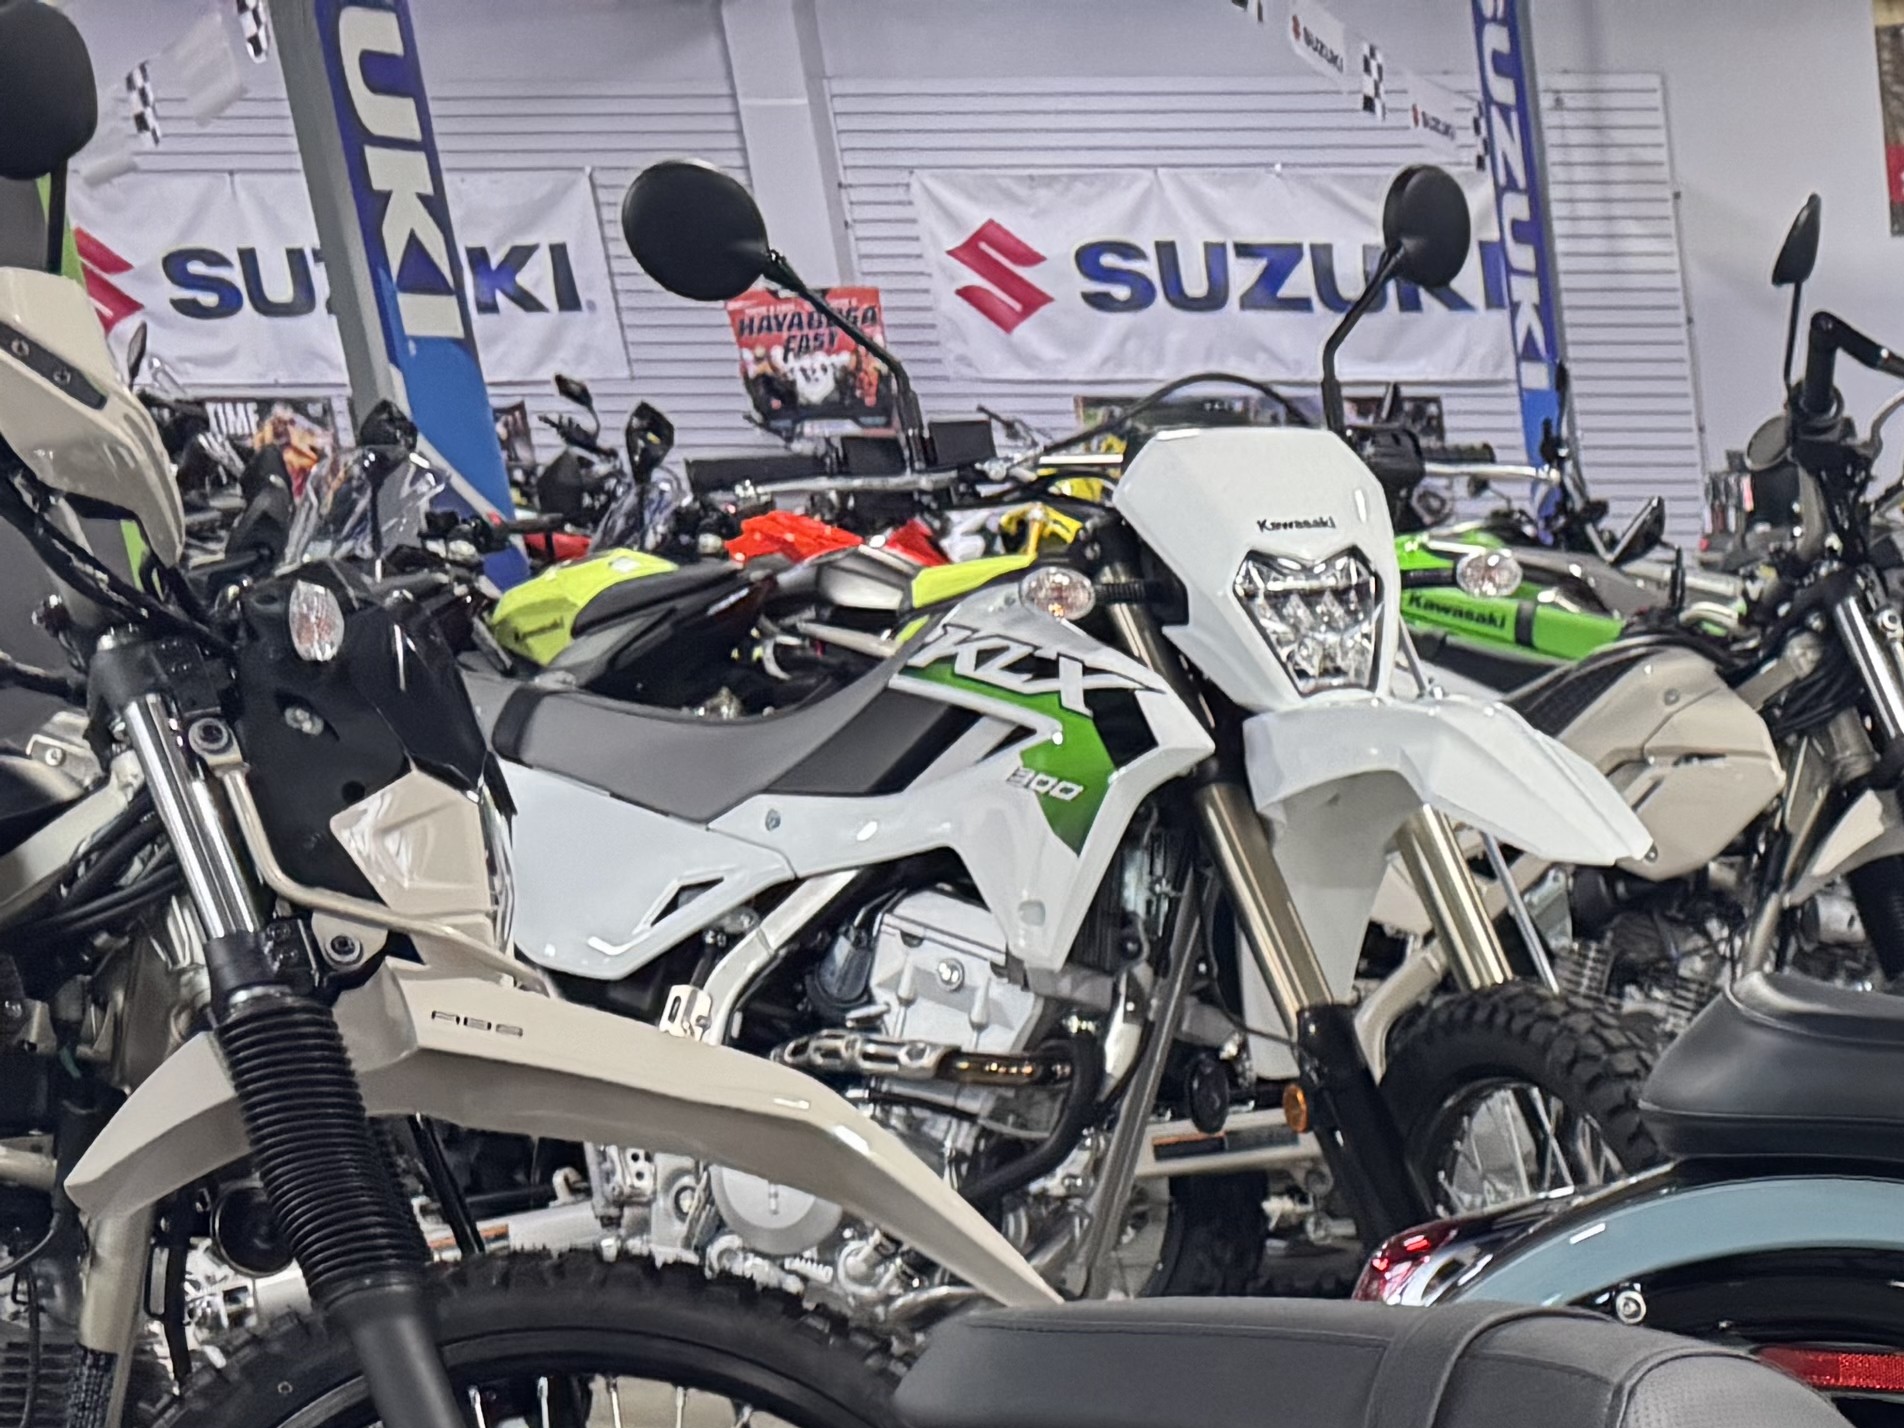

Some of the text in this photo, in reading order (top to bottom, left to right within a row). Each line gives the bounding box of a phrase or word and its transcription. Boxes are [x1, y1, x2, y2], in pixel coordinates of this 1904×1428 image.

[161, 241, 584, 320] SUKI
[1256, 516, 1336, 533] Kawasaki
[1408, 592, 1507, 630] Kawasaki
[907, 623, 1158, 719] KLX
